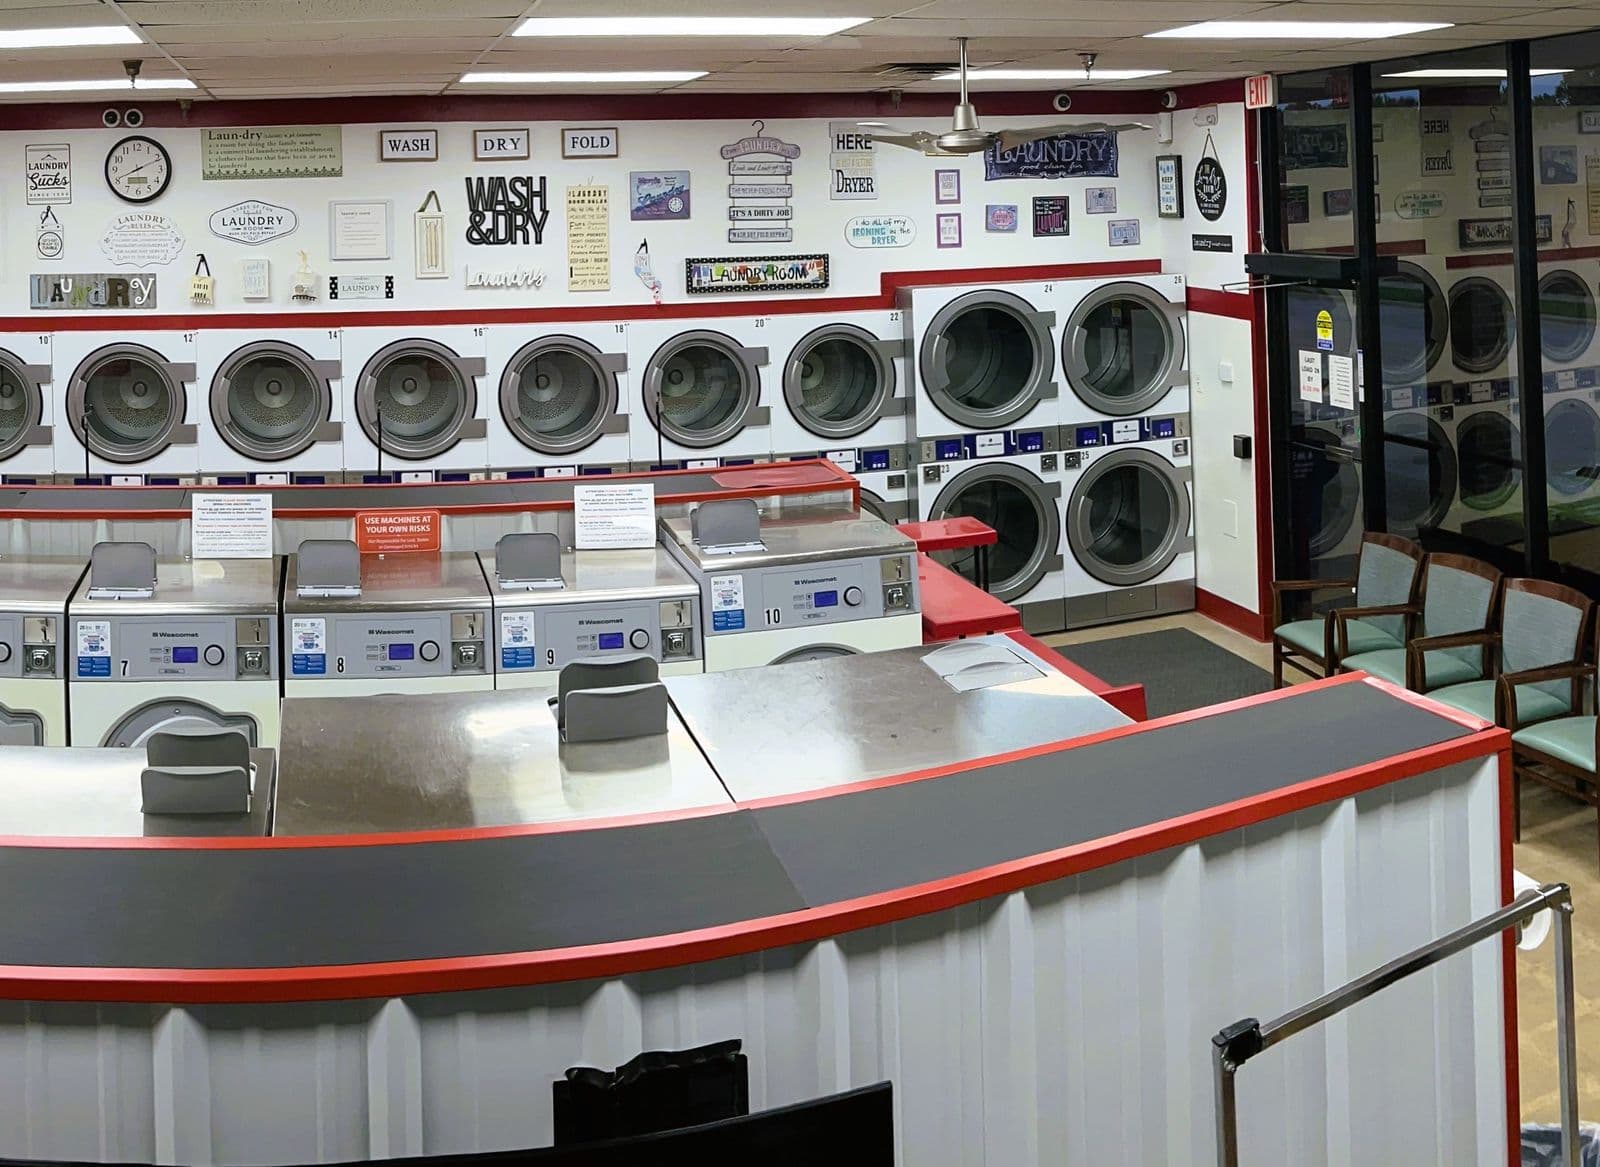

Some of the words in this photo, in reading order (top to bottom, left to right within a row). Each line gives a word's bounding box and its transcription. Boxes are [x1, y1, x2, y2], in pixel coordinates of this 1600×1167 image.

[1249, 76, 1268, 105] EXIT
[388, 139, 430, 152] WASH
[483, 138, 521, 152] DRY
[570, 136, 610, 149] FOLD
[836, 134, 872, 150] HERE
[996, 139, 1108, 164] LAUNDRY
[28, 161, 69, 170] LAUNDRY
[1068, 161, 1083, 173] fun
[29, 172, 70, 190] Sucks
[836, 169, 874, 193] DRYER
[465, 176, 546, 212] WASH
[754, 209, 774, 217] DIRTY
[776, 209, 790, 217] JOB
[118, 214, 165, 224] LAUNDRY
[222, 216, 283, 226] LAUNDRY
[852, 228, 886, 237] IRONING
[871, 236, 898, 245] DRYER
[465, 264, 546, 290] Laundry
[710, 265, 768, 283] LAUNDRY
[771, 264, 807, 281] ROOM
[1174, 275, 1182, 284] 26
[342, 284, 380, 292] LAUNDRY
[1044, 284, 1053, 293] 24
[890, 313, 899, 321] 22
[755, 319, 765, 328] 20
[474, 328, 483, 337] 16
[615, 325, 624, 333] 18
[39, 336, 49, 345] 10
[184, 334, 193, 342] 12
[328, 331, 338, 340] 14
[1081, 452, 1089, 460] 25
[942, 465, 950, 473] 23
[364, 517, 379, 525] USE
[380, 516, 421, 524] MACHINES
[421, 515, 431, 523] AT
[409, 525, 431, 533] RISKS
[766, 608, 780, 624] 10
[547, 650, 554, 665] 9
[121, 660, 128, 676] 7
[337, 657, 344, 673] 8
